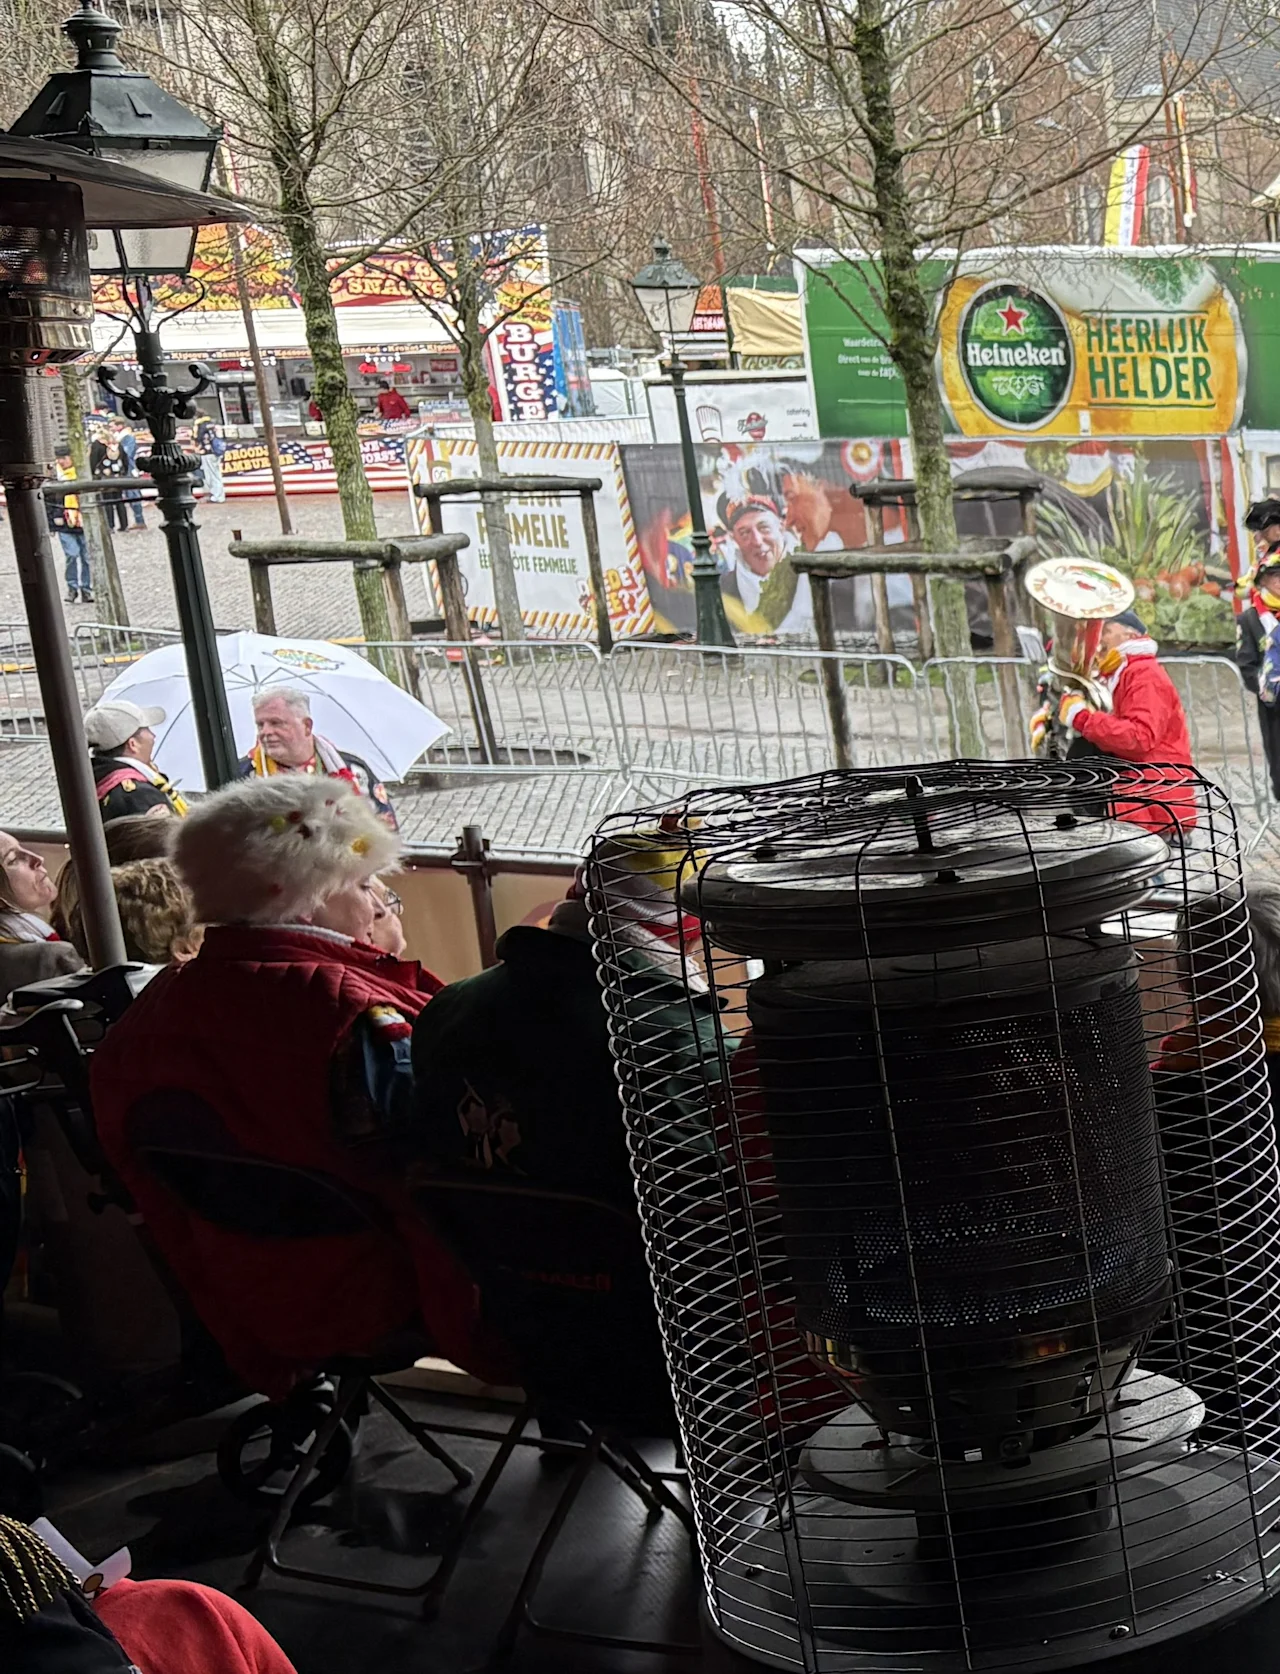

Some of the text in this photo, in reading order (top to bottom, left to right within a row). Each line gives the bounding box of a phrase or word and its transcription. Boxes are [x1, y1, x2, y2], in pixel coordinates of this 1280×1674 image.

[1085, 318, 1209, 353] HEERLIJK
[966, 341, 1067, 367] Heineken
[1088, 356, 1214, 400] HELDER
[532, 557, 578, 575] FEMMELIE
